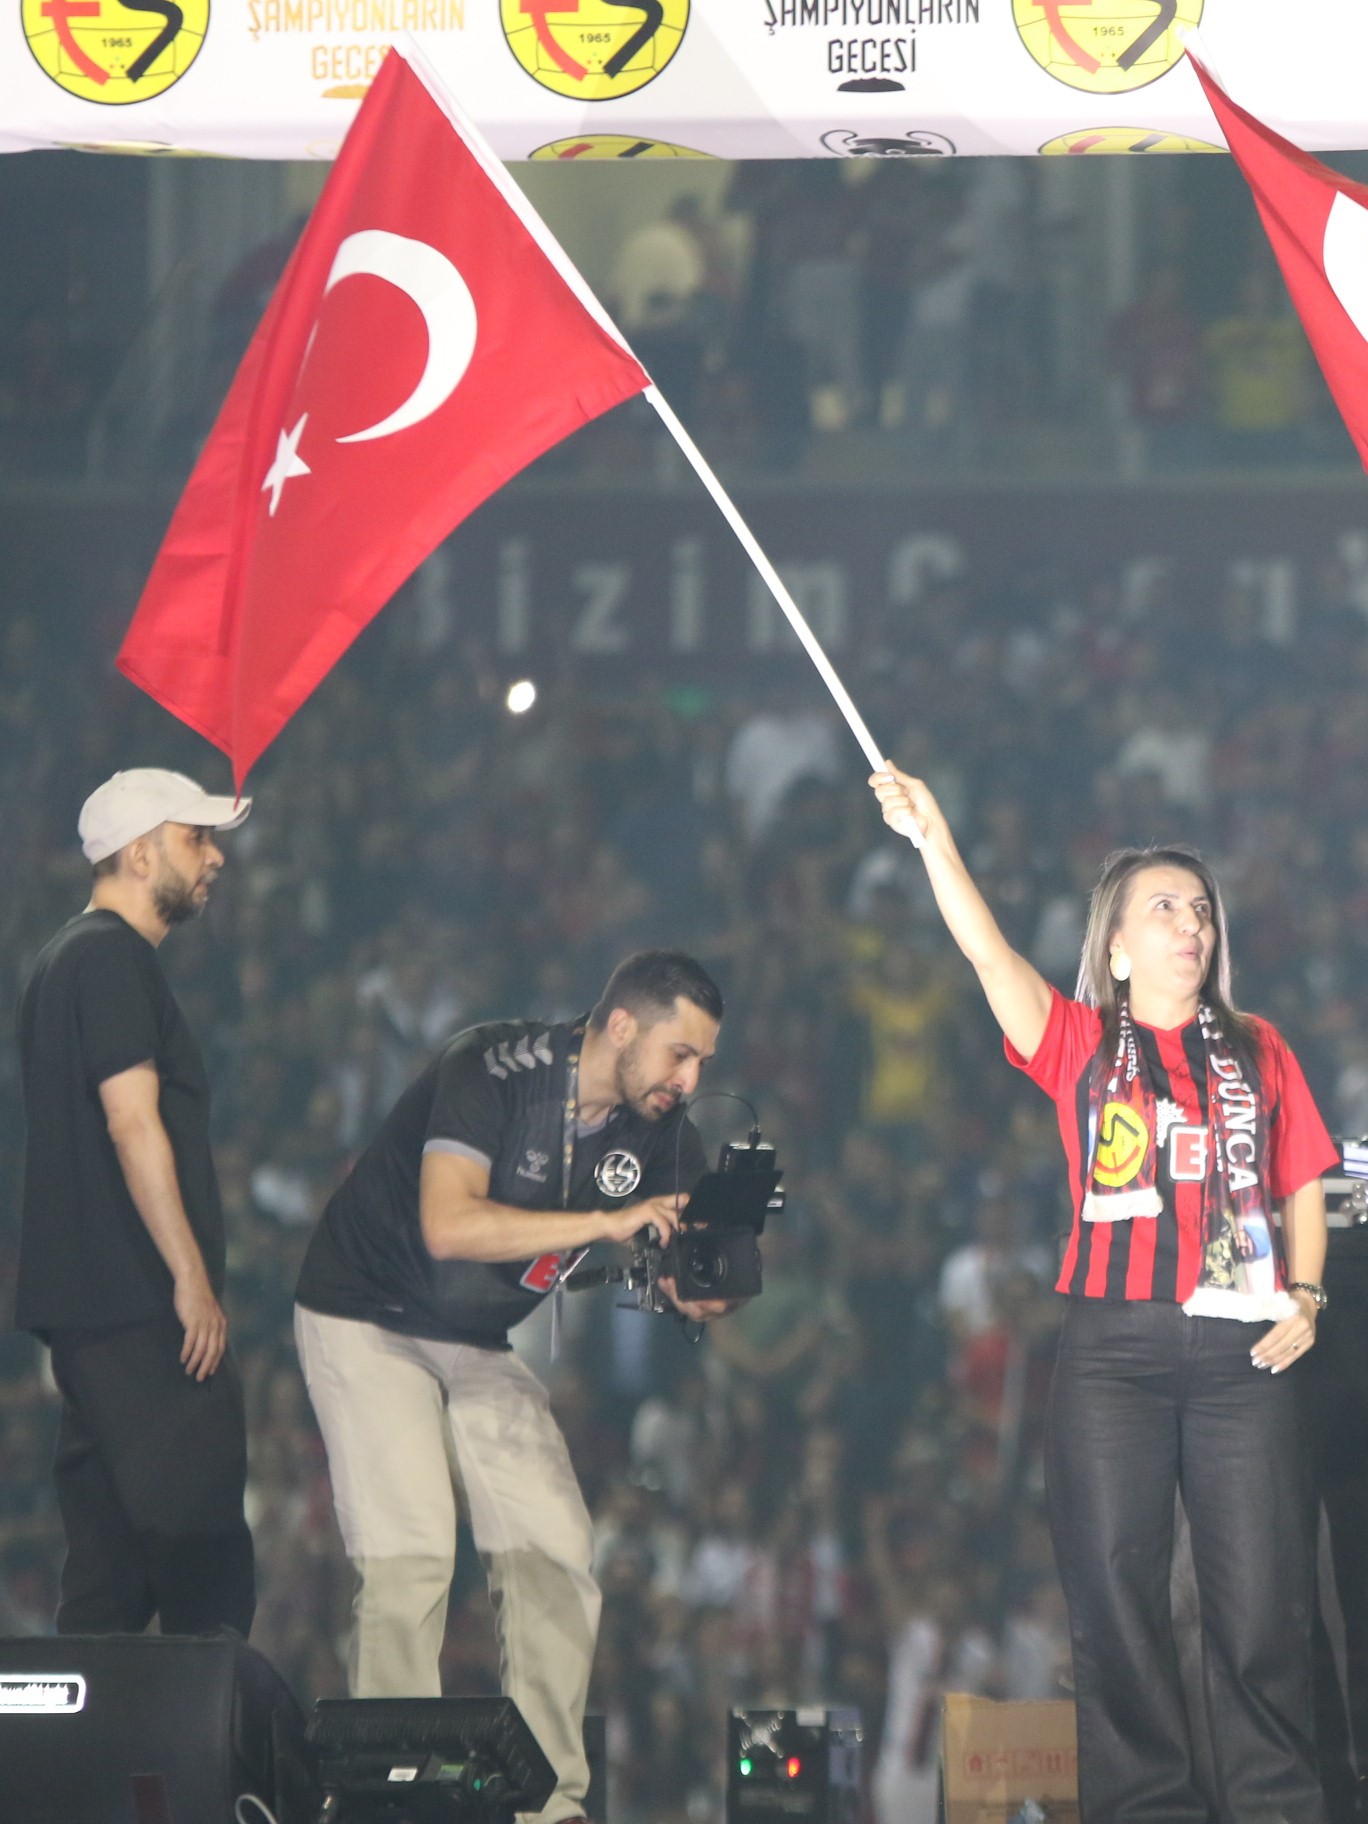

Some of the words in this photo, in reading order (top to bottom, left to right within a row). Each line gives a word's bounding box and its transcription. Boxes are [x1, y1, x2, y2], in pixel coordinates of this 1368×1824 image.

[1092, 26, 1125, 37] 1965
[101, 37, 133, 48] 1965
[579, 33, 611, 44] 1965
[828, 28, 916, 74] GECESİ
[311, 44, 391, 80] GECE
